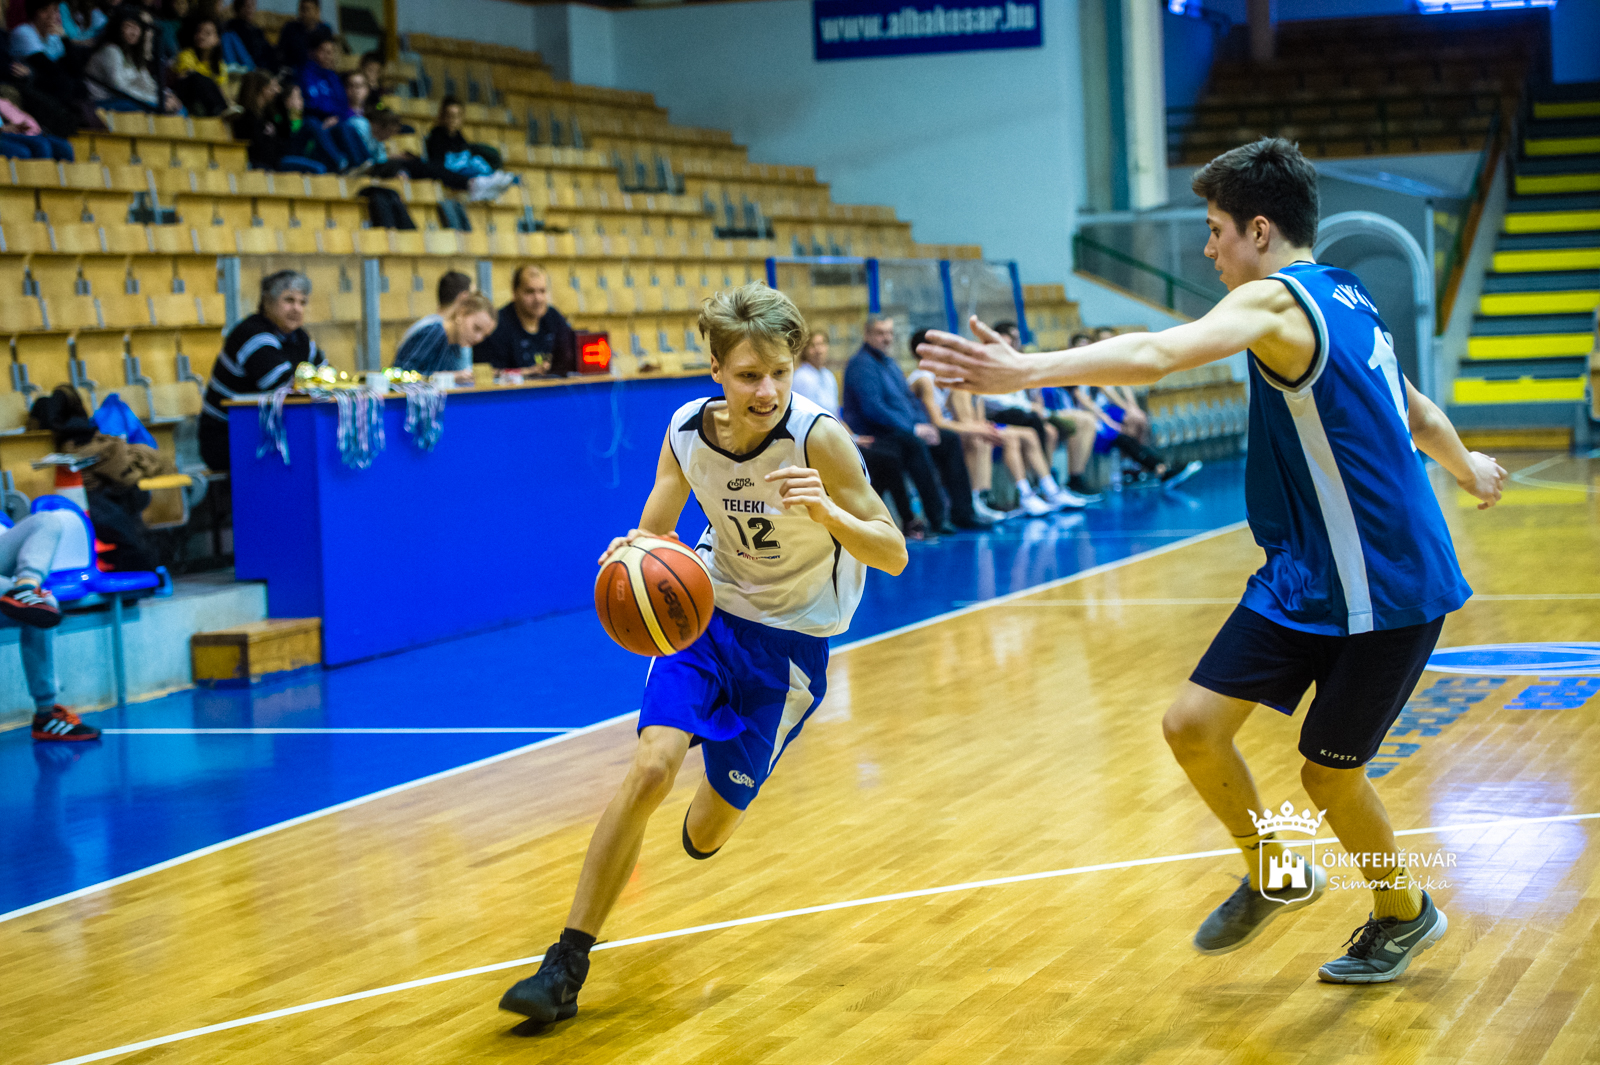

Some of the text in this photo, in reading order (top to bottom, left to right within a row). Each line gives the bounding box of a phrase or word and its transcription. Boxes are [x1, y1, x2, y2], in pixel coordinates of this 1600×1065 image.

[820, 1, 1036, 43] www.albakosar.hu
[722, 498, 765, 514] TELEKI
[727, 515, 781, 551] 12
[1320, 749, 1357, 761] KIPSTA
